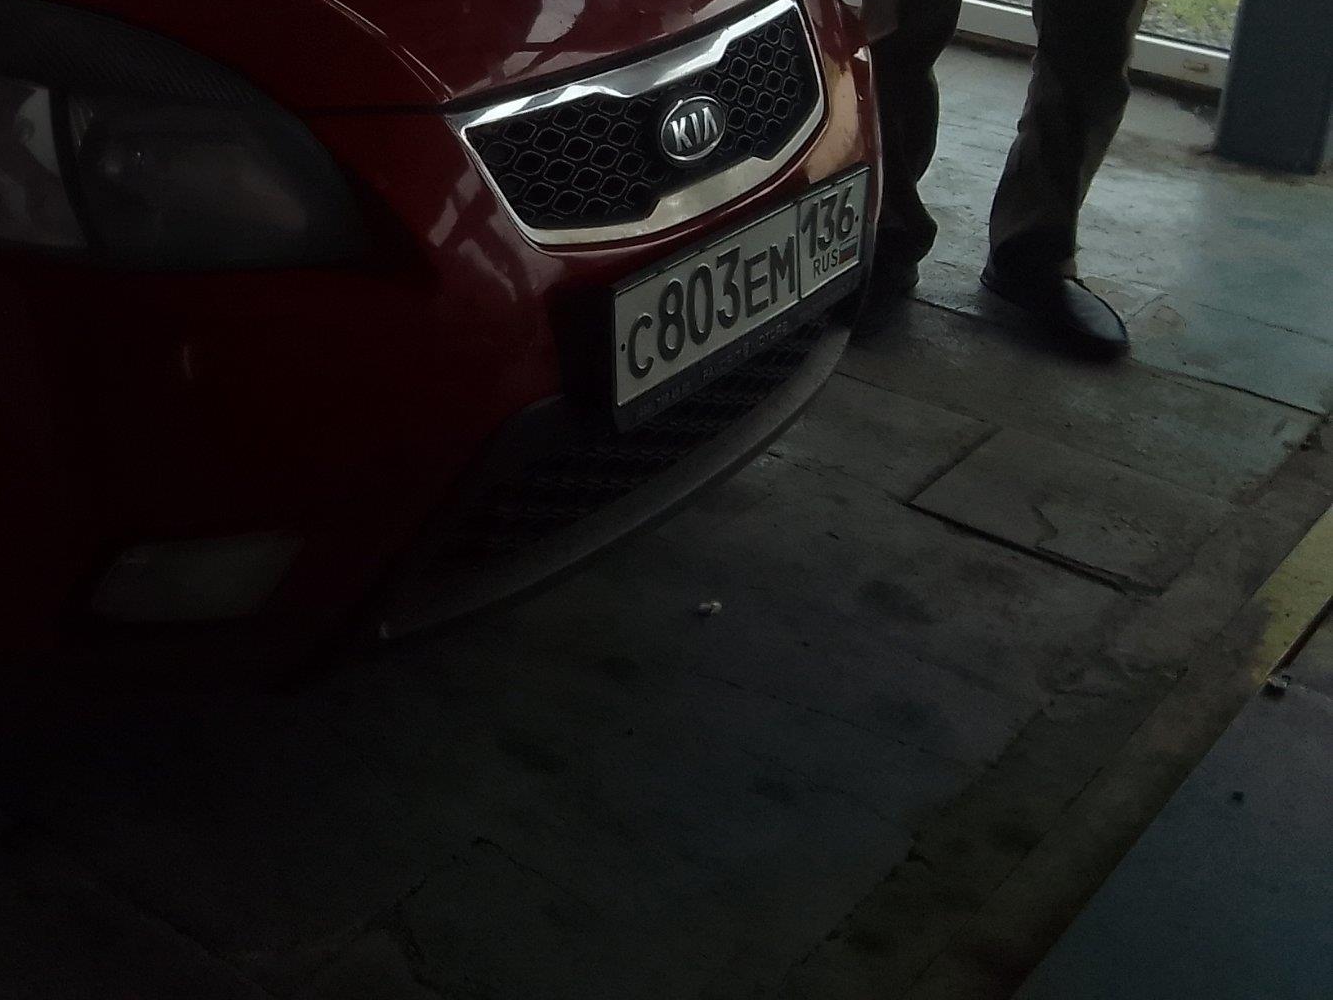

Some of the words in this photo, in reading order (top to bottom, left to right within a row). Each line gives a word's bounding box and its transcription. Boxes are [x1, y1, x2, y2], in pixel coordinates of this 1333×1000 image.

[670, 106, 719, 152] KIA
[628, 235, 796, 379] С803ЕМ
[801, 183, 855, 258] 136
[813, 249, 839, 279] RUS
